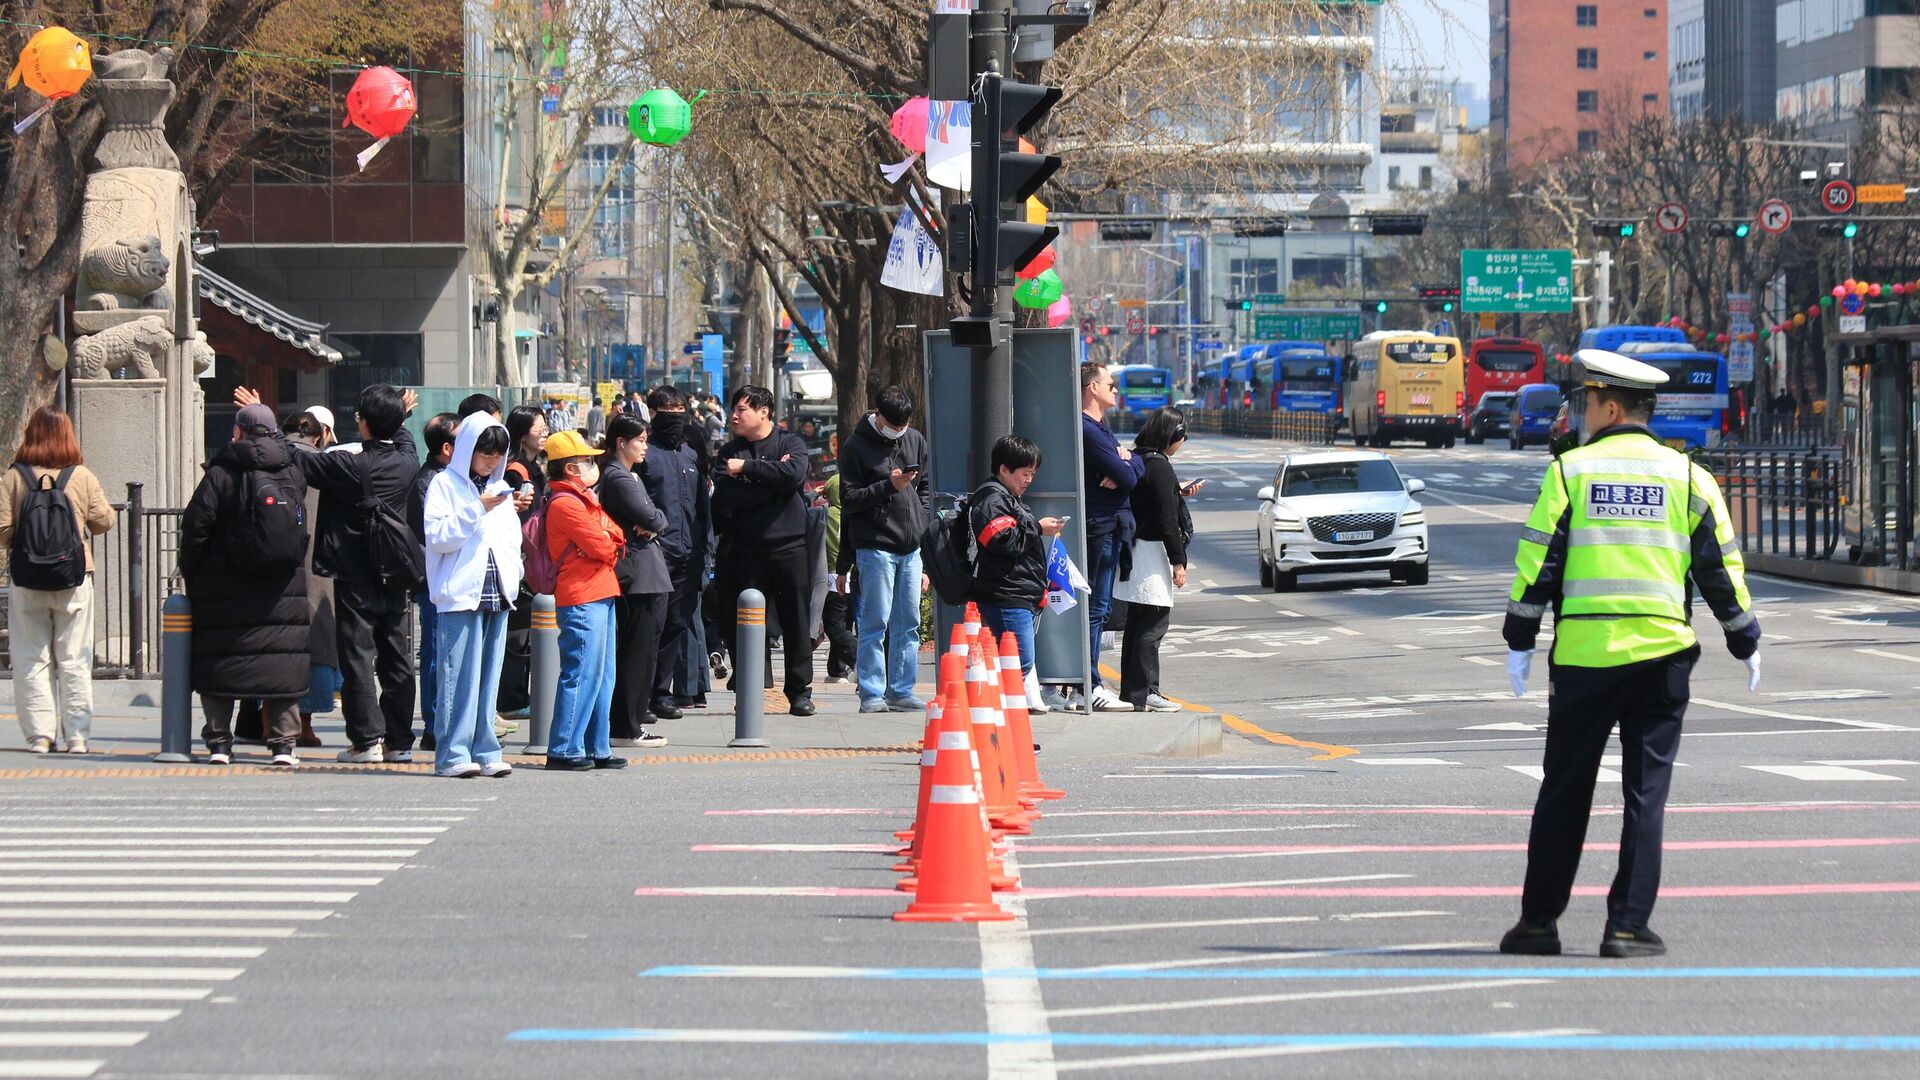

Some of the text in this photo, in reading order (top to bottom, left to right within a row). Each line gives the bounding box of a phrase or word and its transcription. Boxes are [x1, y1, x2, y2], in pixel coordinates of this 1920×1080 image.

[1829, 188, 1848, 205] 50
[1692, 372, 1712, 384] 272
[1594, 485, 1662, 505] 교통경찰
[1596, 506, 1660, 517] POLICE
